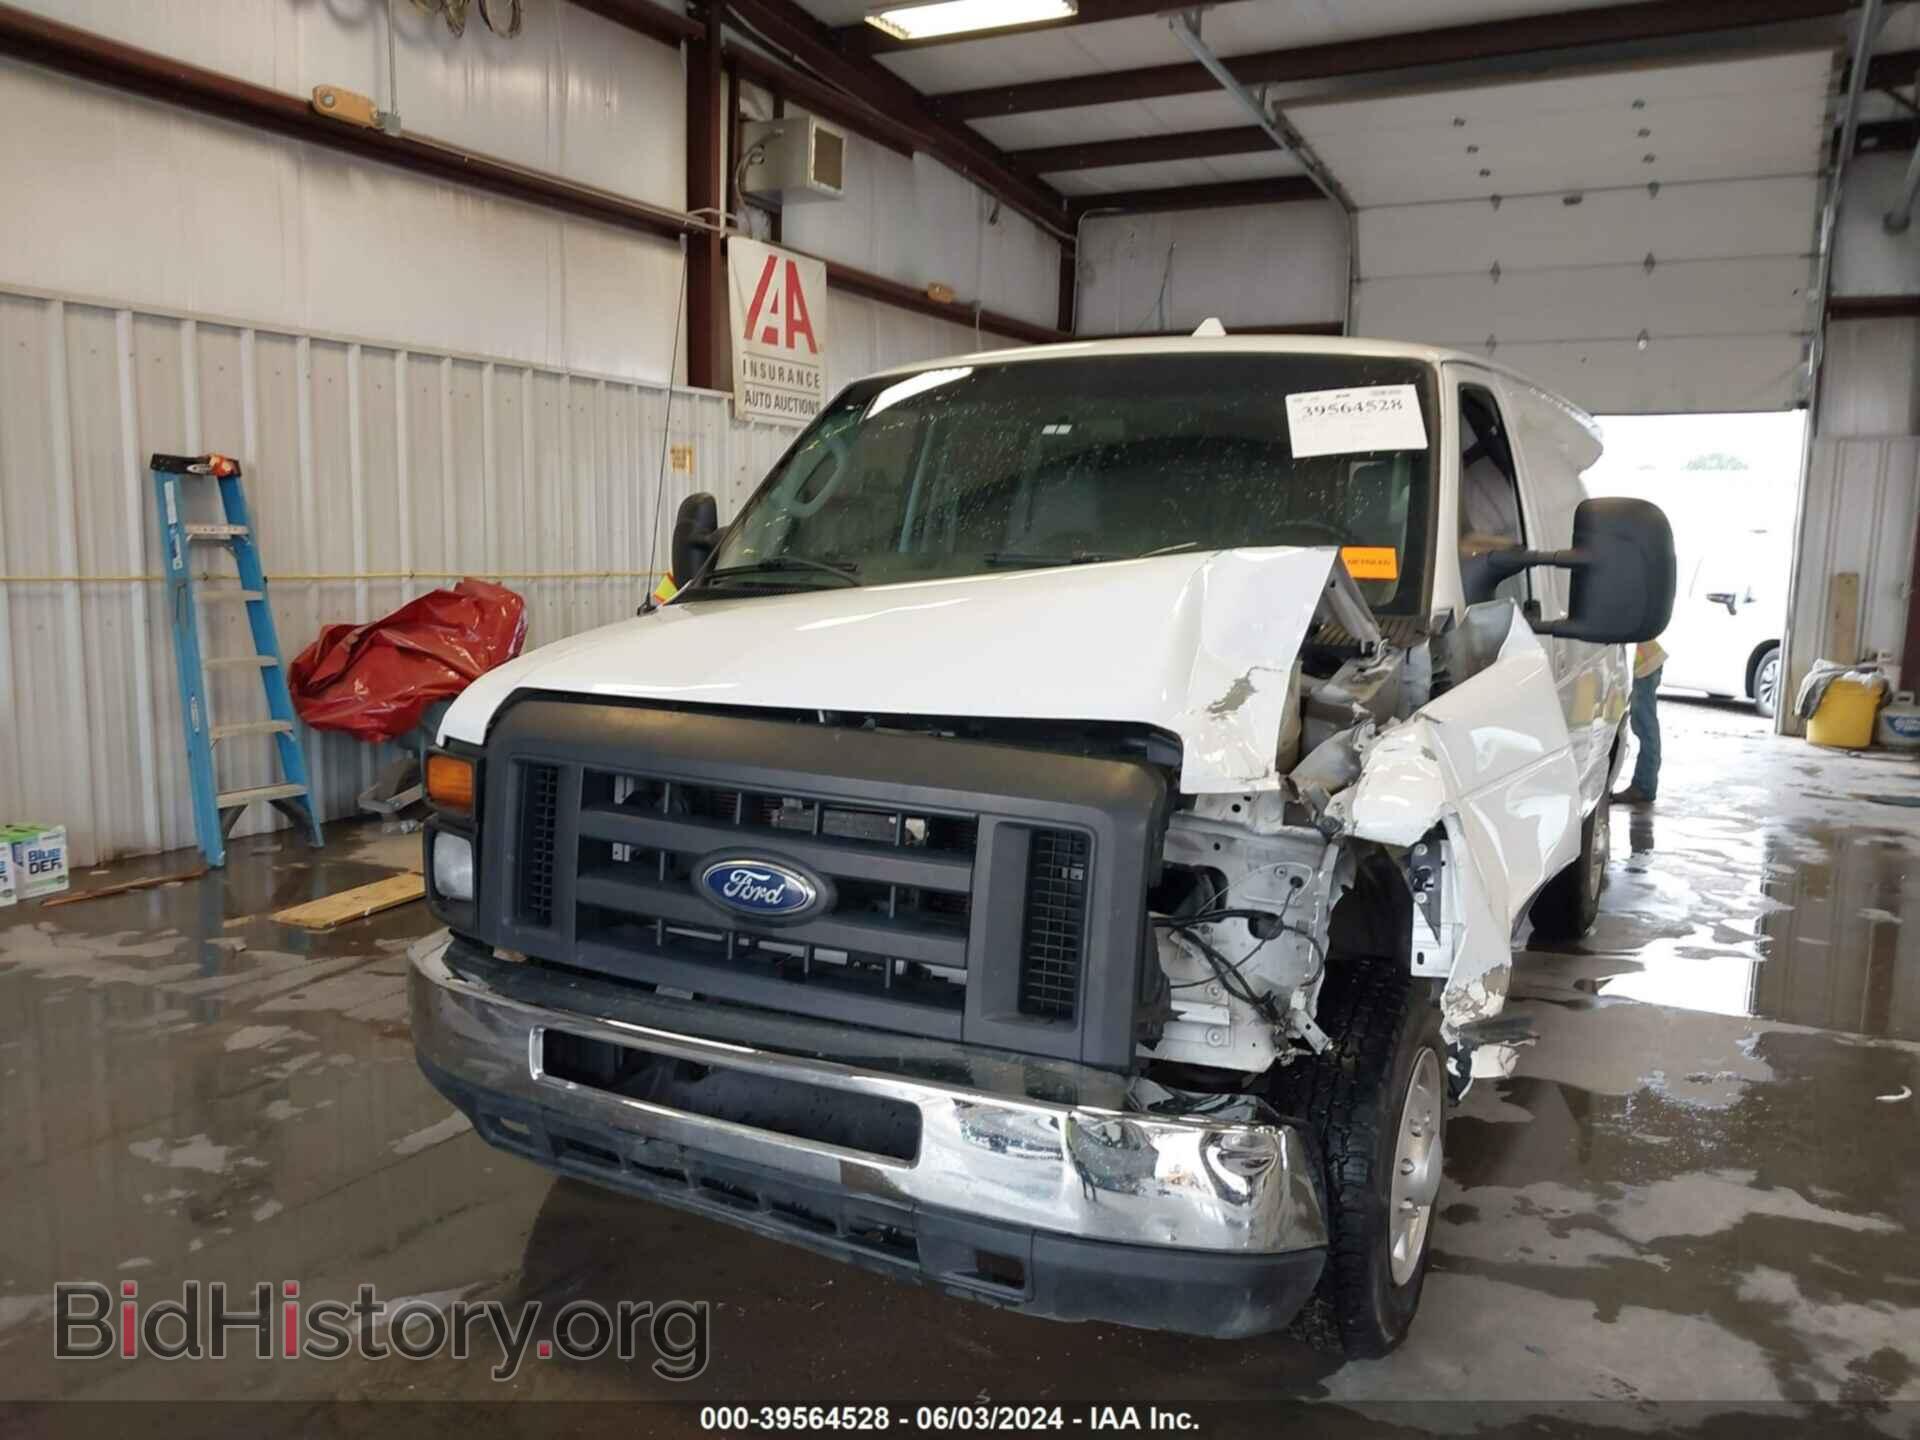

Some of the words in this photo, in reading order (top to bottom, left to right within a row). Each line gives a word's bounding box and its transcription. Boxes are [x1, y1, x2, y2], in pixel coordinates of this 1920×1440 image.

[744, 254, 818, 354] IAA
[743, 359, 820, 389] INSURANCE
[745, 390, 772, 409] AUTO
[774, 393, 821, 417] AUCTIONS
[1303, 399, 1403, 417] 39564528
[29, 857, 61, 874] DEF
[723, 869, 785, 904] Ford
